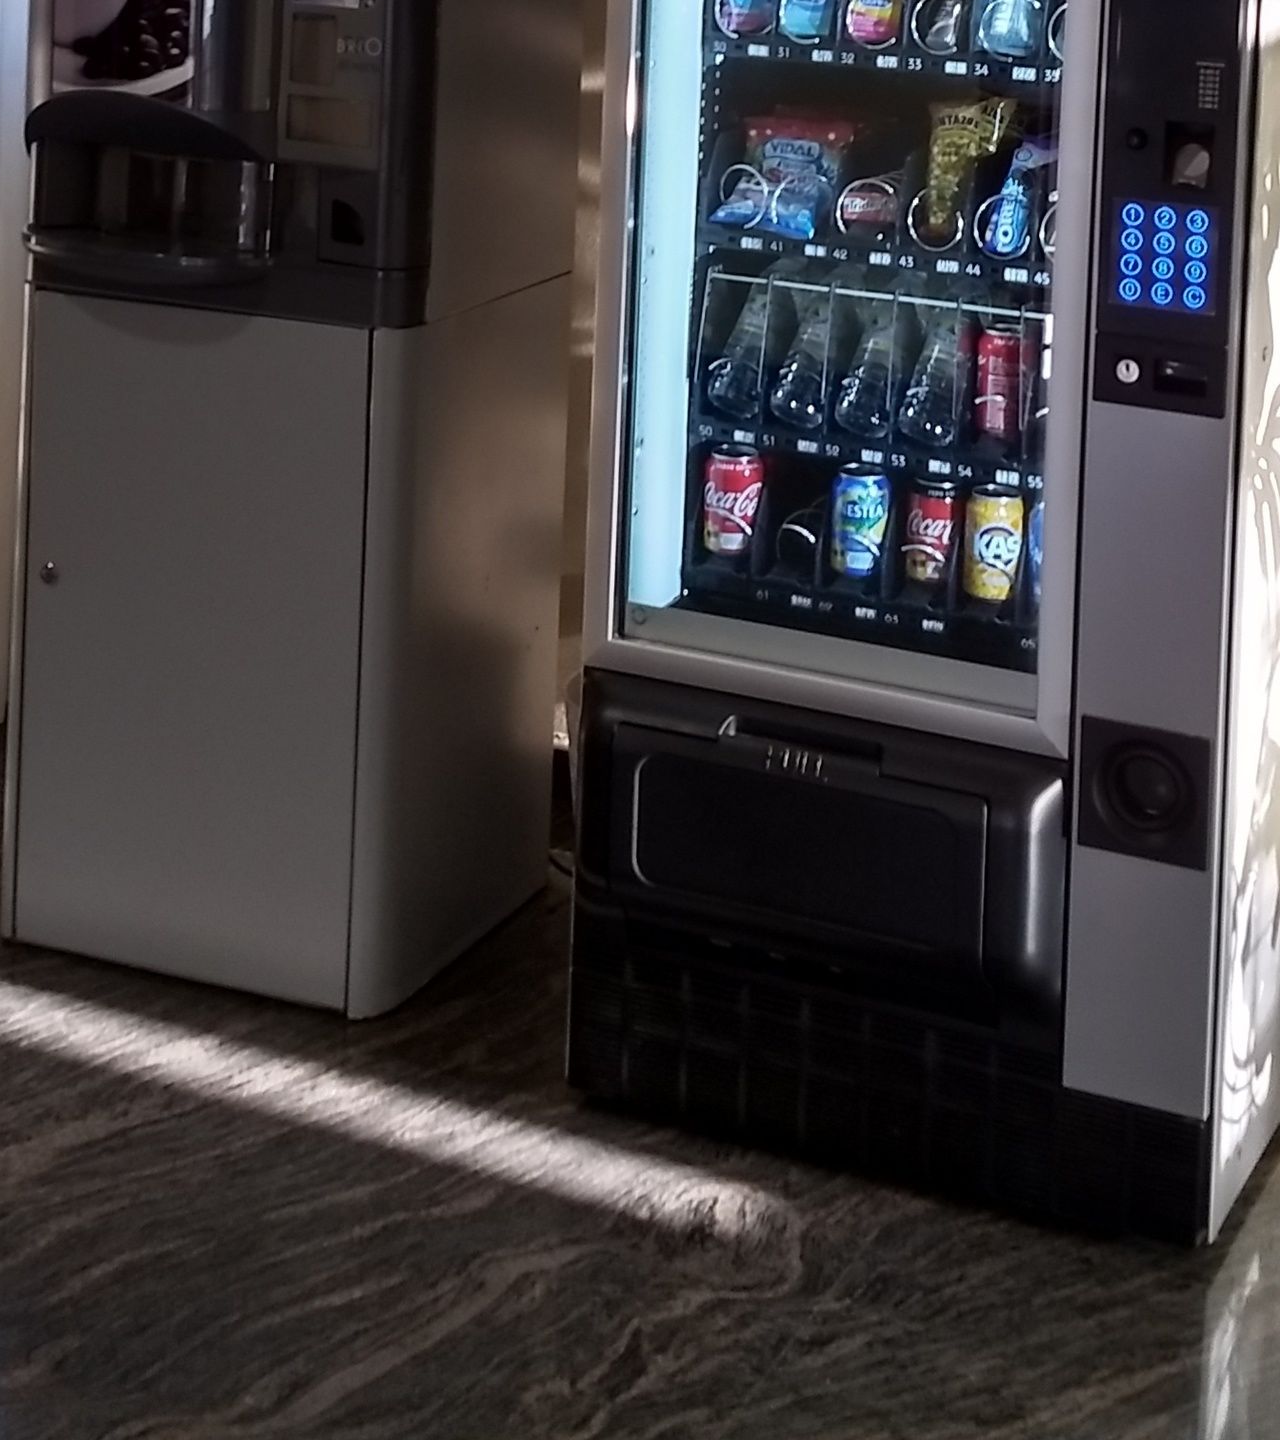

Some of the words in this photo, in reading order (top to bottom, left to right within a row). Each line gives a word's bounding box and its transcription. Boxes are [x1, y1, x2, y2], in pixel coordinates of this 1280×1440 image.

[776, 46, 790, 58] 31
[841, 52, 855, 64] 32
[907, 57, 922, 70] 33
[973, 63, 990, 77] 34
[1043, 69, 1062, 83] 35
[770, 141, 815, 157] VIDAL
[770, 240, 783, 252] 41
[833, 247, 848, 260] 42
[899, 255, 915, 268] 43
[965, 264, 981, 277] 44
[1033, 271, 1050, 286] 45
[698, 425, 713, 437] 50
[762, 433, 776, 447] 51
[825, 444, 840, 457] 52
[891, 454, 907, 468] 53
[957, 465, 972, 479] 54
[1027, 474, 1044, 489] 55
